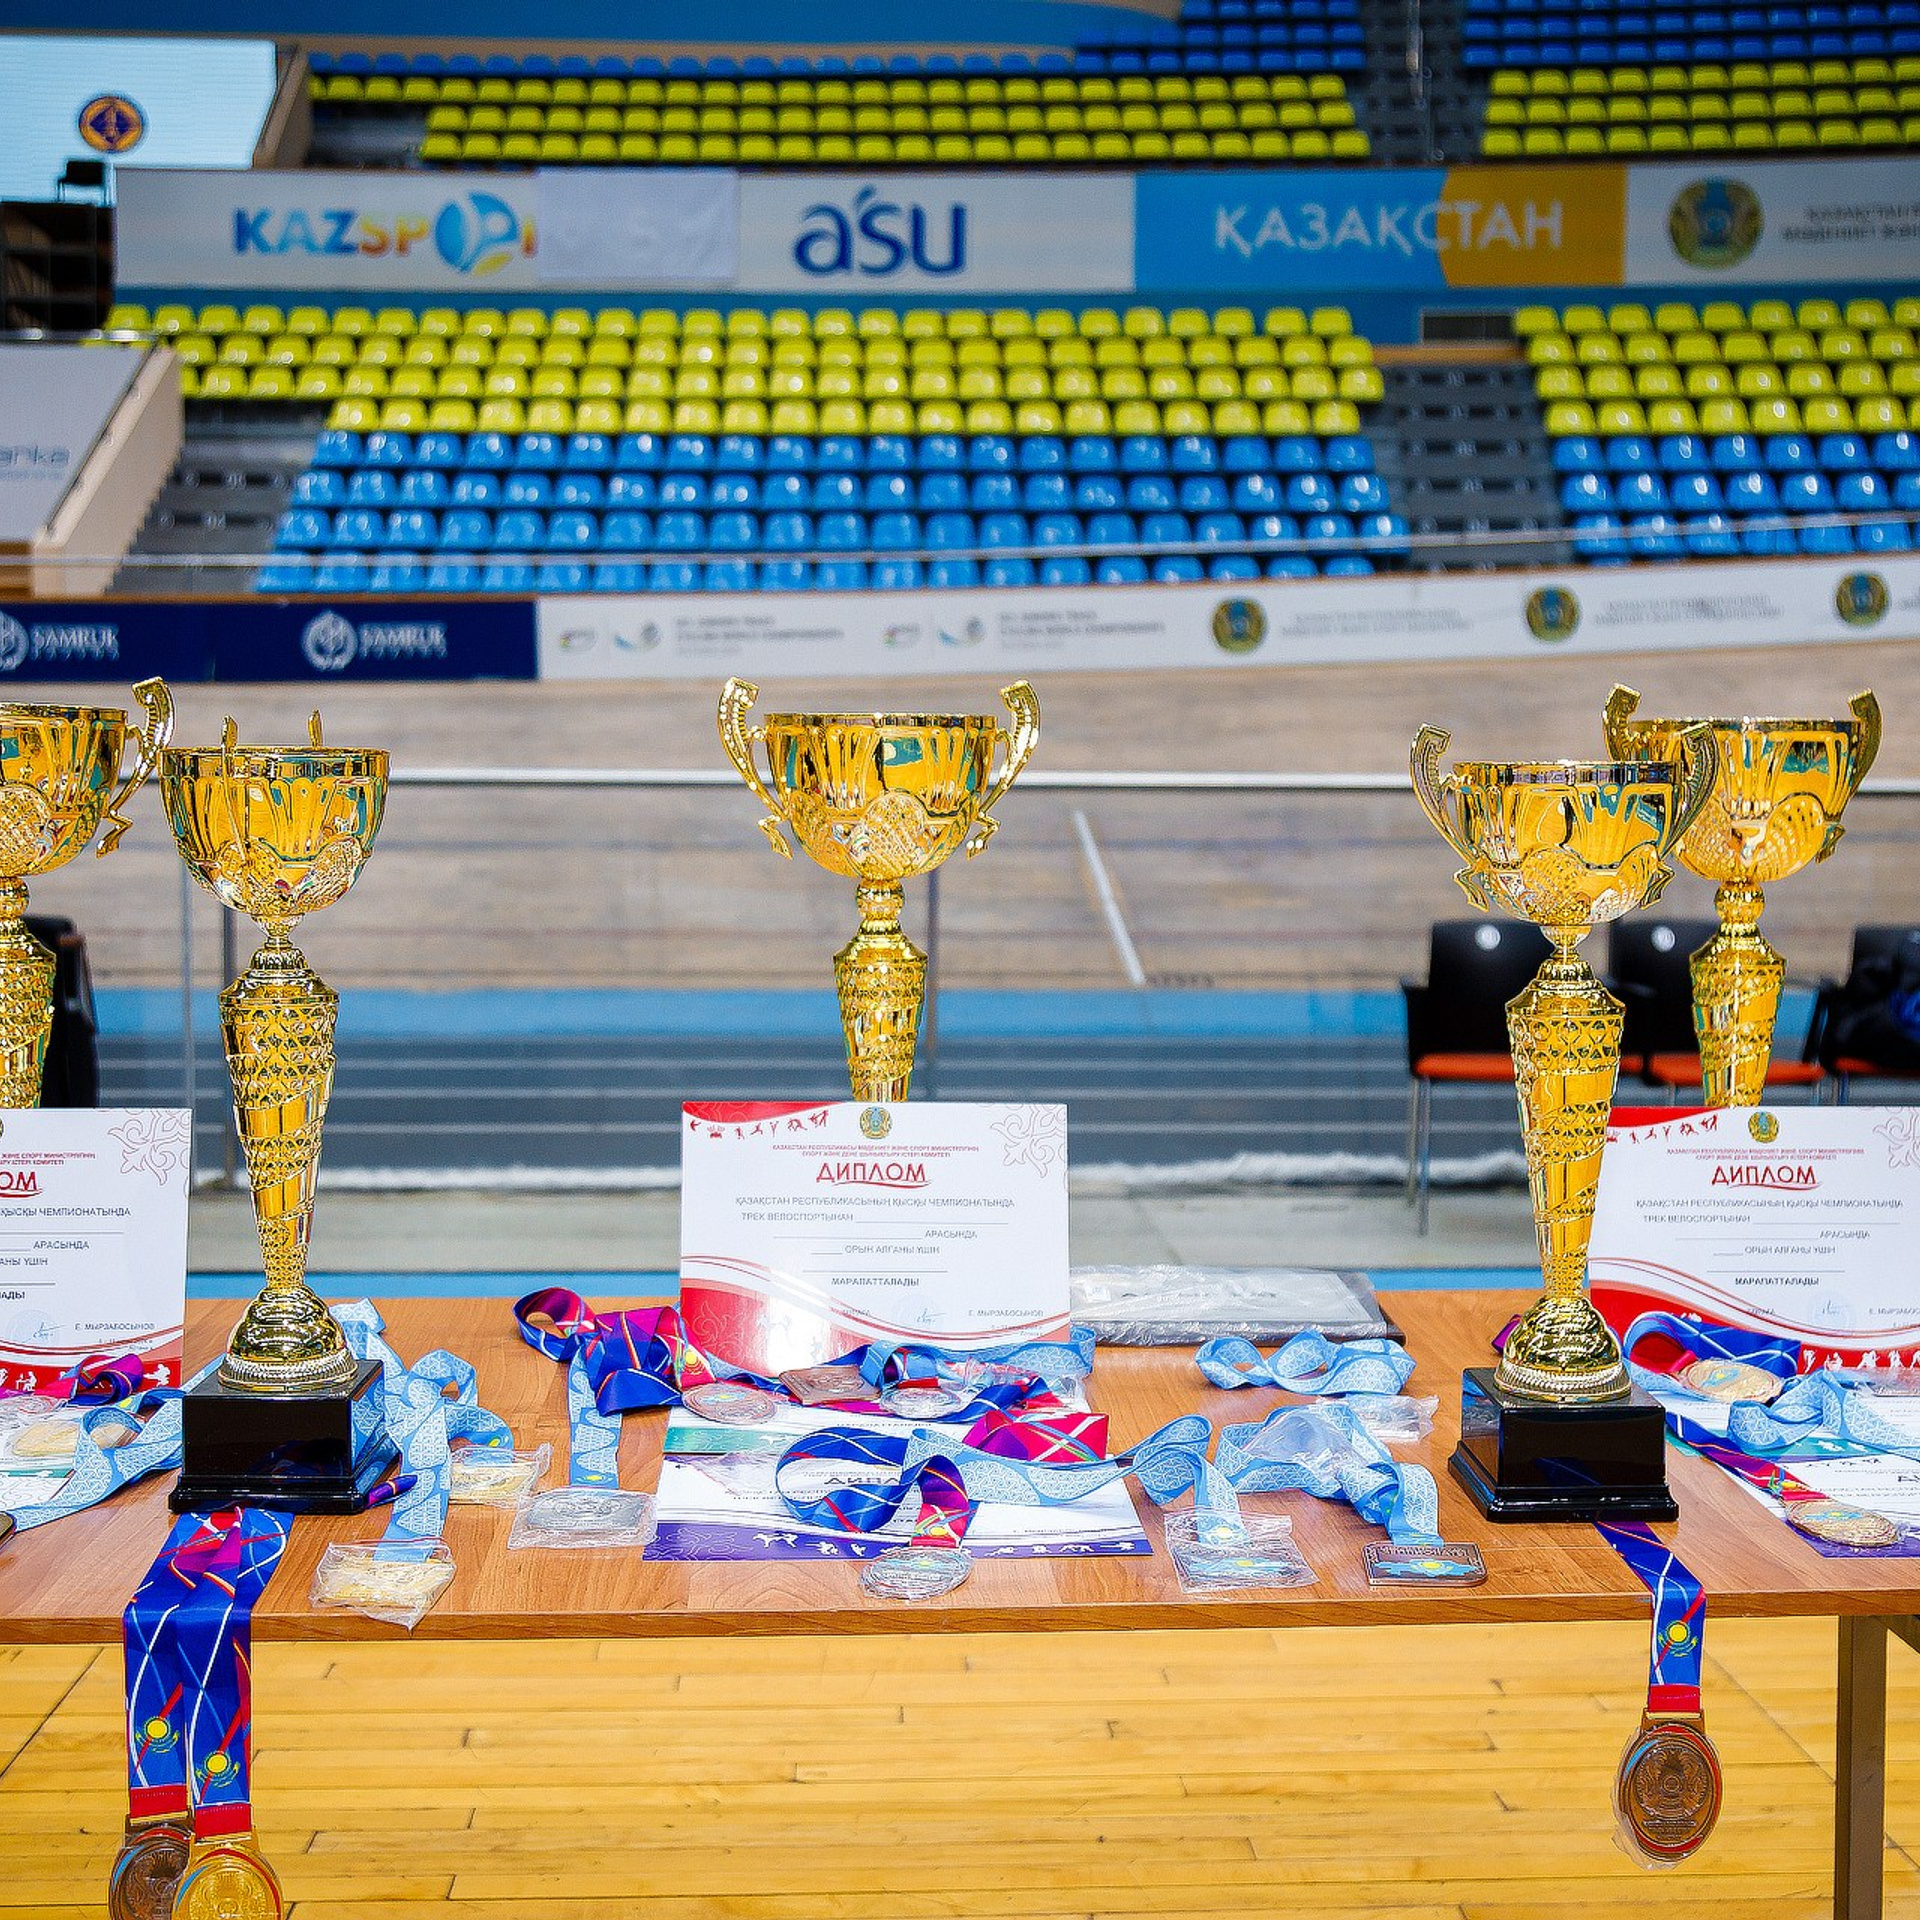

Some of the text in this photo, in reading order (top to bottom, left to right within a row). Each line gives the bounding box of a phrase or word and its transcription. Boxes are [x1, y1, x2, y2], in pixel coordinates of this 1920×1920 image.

[816, 1162, 926, 1183] ДИПЛОМ
[1711, 1165, 1816, 1186] ДИПЛОМ
[38, 1207, 132, 1217] ЧЕМПИОНАТЫНДА
[924, 1229, 978, 1240] АРАСЫНДА
[33, 1240, 90, 1250] АРАСЫНДА
[0, 1291, 26, 1300] АДЫ
